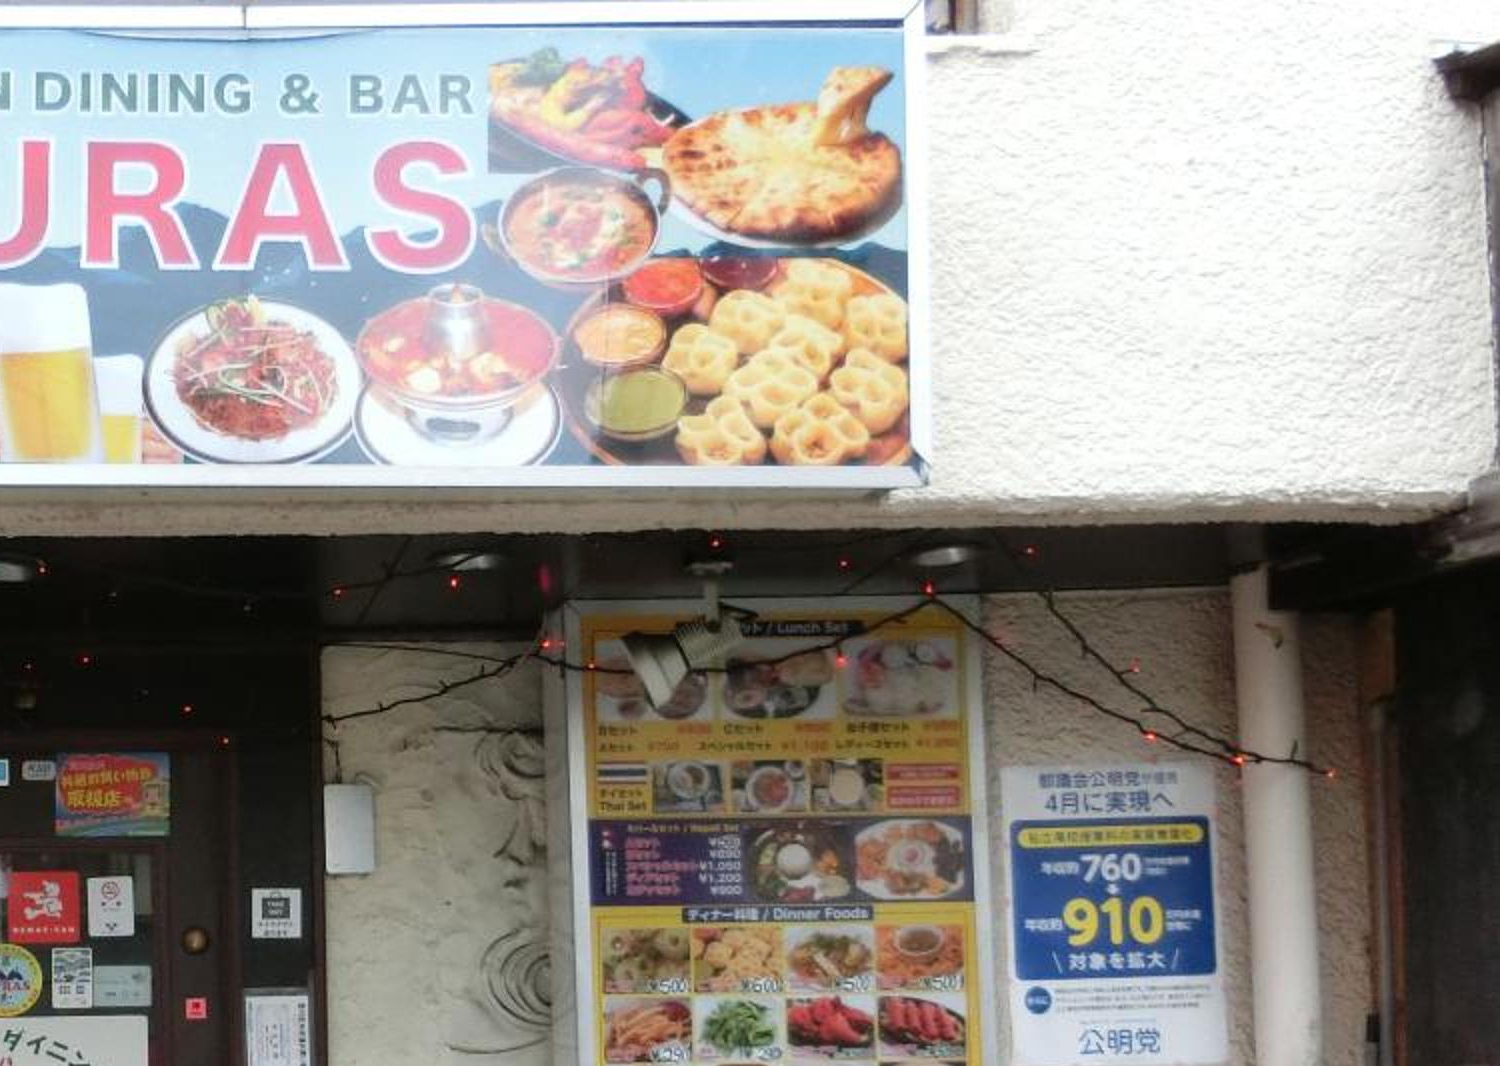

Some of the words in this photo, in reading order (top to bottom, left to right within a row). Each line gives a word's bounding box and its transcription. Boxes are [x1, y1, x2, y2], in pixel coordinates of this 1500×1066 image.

[35, 72, 251, 113] DINING
[278, 74, 319, 113] &
[350, 73, 474, 114] BAR
[777, 622, 824, 635] Lunch
[828, 622, 849, 634] Set
[1044, 790, 1174, 813] 4月に実現へ
[1080, 852, 1143, 883] 760
[773, 907, 820, 920] Dinner
[824, 907, 869, 920] Foods
[1062, 895, 1165, 948] 910
[1079, 1028, 1161, 1056] 公明党
